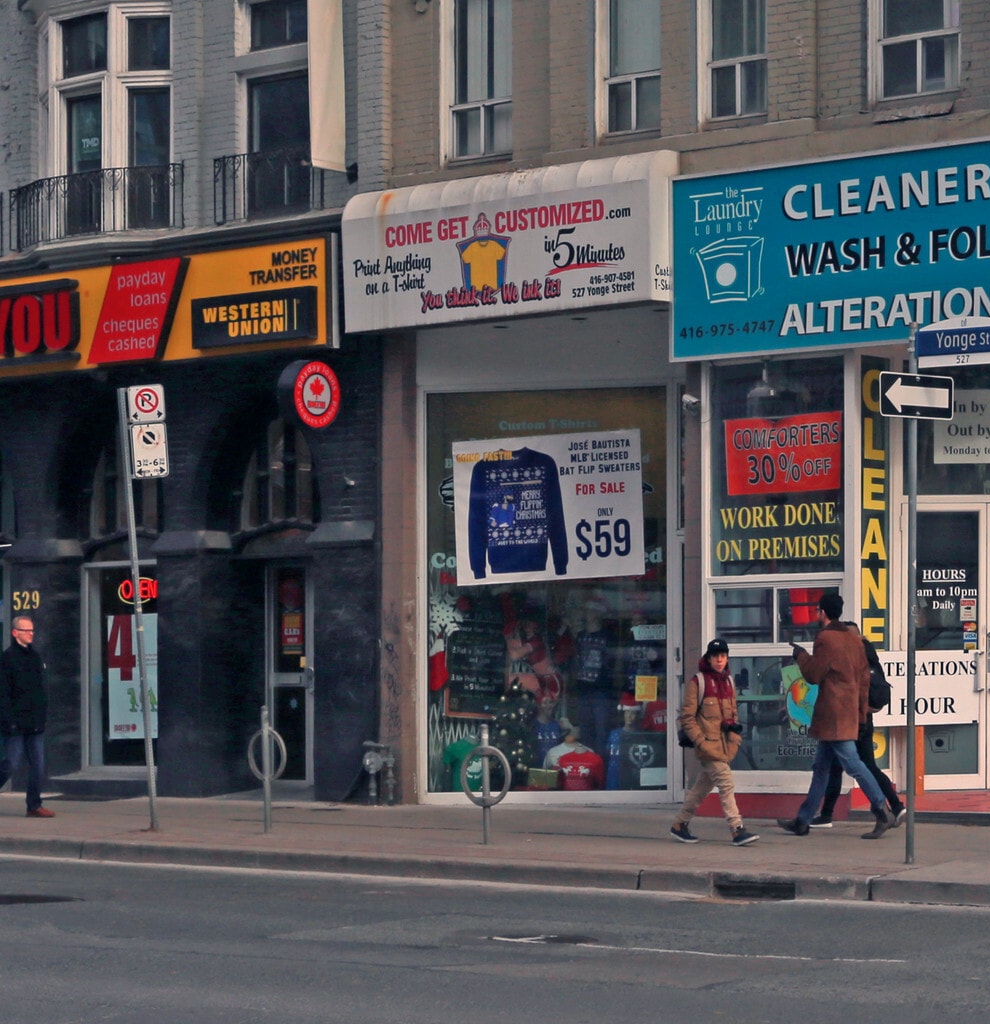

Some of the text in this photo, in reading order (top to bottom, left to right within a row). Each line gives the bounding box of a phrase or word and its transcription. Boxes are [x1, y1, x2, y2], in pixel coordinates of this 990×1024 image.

[725, 187, 738, 198] the
[693, 194, 763, 223] Laundry
[385, 221, 433, 248] COME
[437, 216, 469, 241] GET
[544, 226, 625, 269] in 5 Minutes
[785, 235, 886, 278] WASH
[895, 231, 921, 266] &
[271, 247, 317, 267] MONEY
[353, 253, 431, 277] Print Anything
[249, 264, 317, 286] TRANSFER
[589, 271, 635, 285] 416-907-4581
[654, 263, 671, 276] Cust
[117, 270, 166, 291] payday
[365, 274, 425, 296] on a T-shirt
[130, 291, 167, 307] loans
[420, 277, 562, 314] You think it. We ink it!
[572, 282, 635, 298] 527 Yonge Street
[202, 299, 284, 324] WESTERN
[102, 316, 159, 334] cheques
[228, 317, 284, 338] UNION
[679, 320, 775, 339] 416-975-4747
[108, 335, 155, 352] cashed
[936, 332, 990, 351] Yonge St
[956, 355, 970, 364] 527
[953, 401, 966, 413] In
[971, 400, 986, 416] by
[733, 422, 841, 450] COMFORTERS
[947, 423, 973, 437] Out
[591, 439, 630, 450] BAUTISTA
[943, 445, 981, 457] Monday
[591, 451, 629, 462] LICENSED
[559, 465, 574, 476] BAT
[598, 462, 641, 473] SWEATERS
[803, 457, 832, 476] OFF
[521, 489, 541, 501] MERRY
[575, 481, 625, 495] FOR SALE
[515, 509, 547, 520] CHRISTMAS
[597, 507, 614, 517] ONLY
[720, 502, 836, 530] WORK DONE
[575, 518, 631, 561] $59
[716, 534, 841, 562] ON PREMISES
[861, 369, 887, 759] CLEANES
[922, 569, 966, 580] HOURS
[121, 579, 159, 599] OEN
[917, 586, 977, 598] am to 10pm
[13, 590, 40, 611] 529
[932, 600, 955, 611] Daily
[884, 660, 976, 676] TEATIONS
[900, 697, 956, 715] HOUR
[777, 745, 816, 756] Eco-Frie
